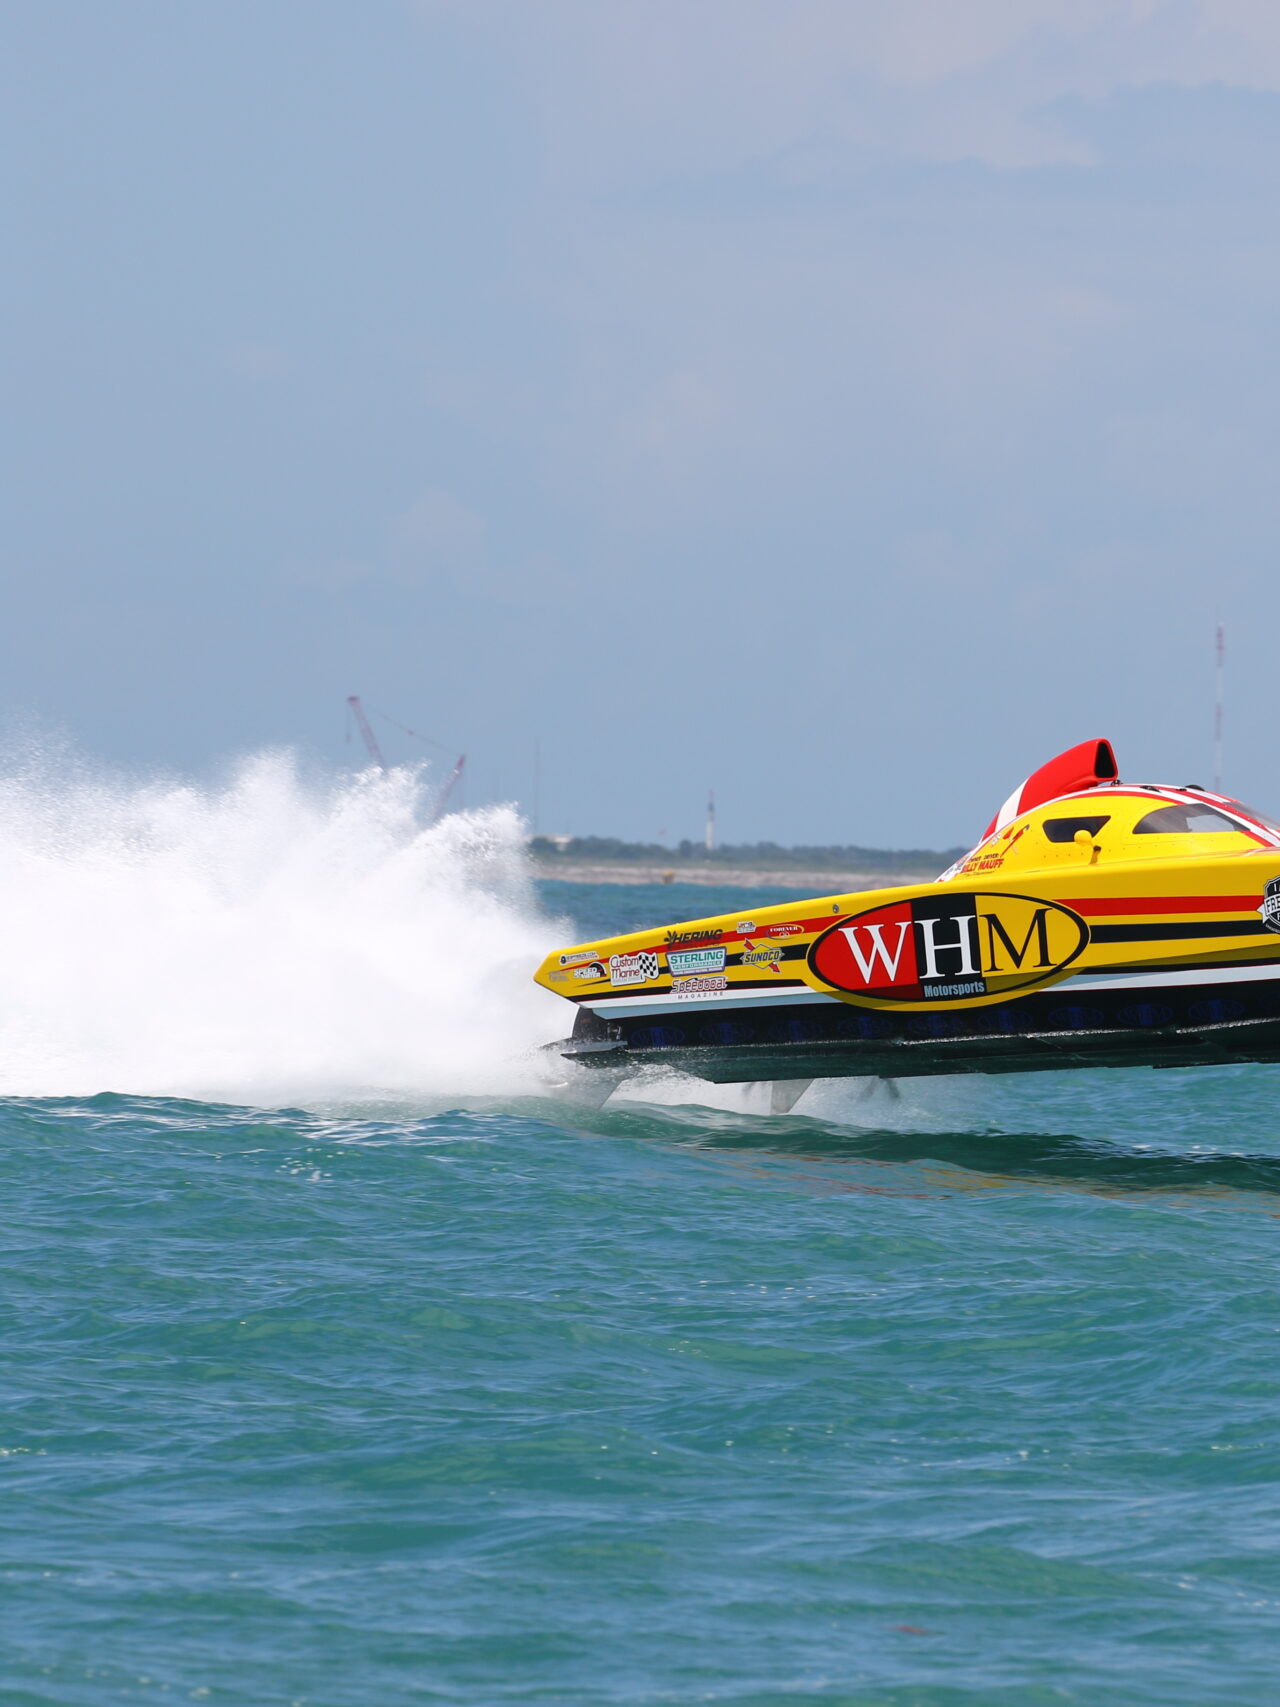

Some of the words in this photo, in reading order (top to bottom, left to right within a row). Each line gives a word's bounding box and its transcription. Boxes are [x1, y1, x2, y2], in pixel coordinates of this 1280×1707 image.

[978, 858, 1004, 870] MAUFF
[672, 929, 723, 944] HERING
[838, 908, 1058, 985] WHM
[610, 956, 639, 969] Custom
[670, 951, 723, 965] STERLING
[745, 950, 780, 963] SUNOCO
[611, 967, 640, 980] Marine
[671, 977, 728, 994] Speedboat
[924, 981, 985, 998] Motorsports
